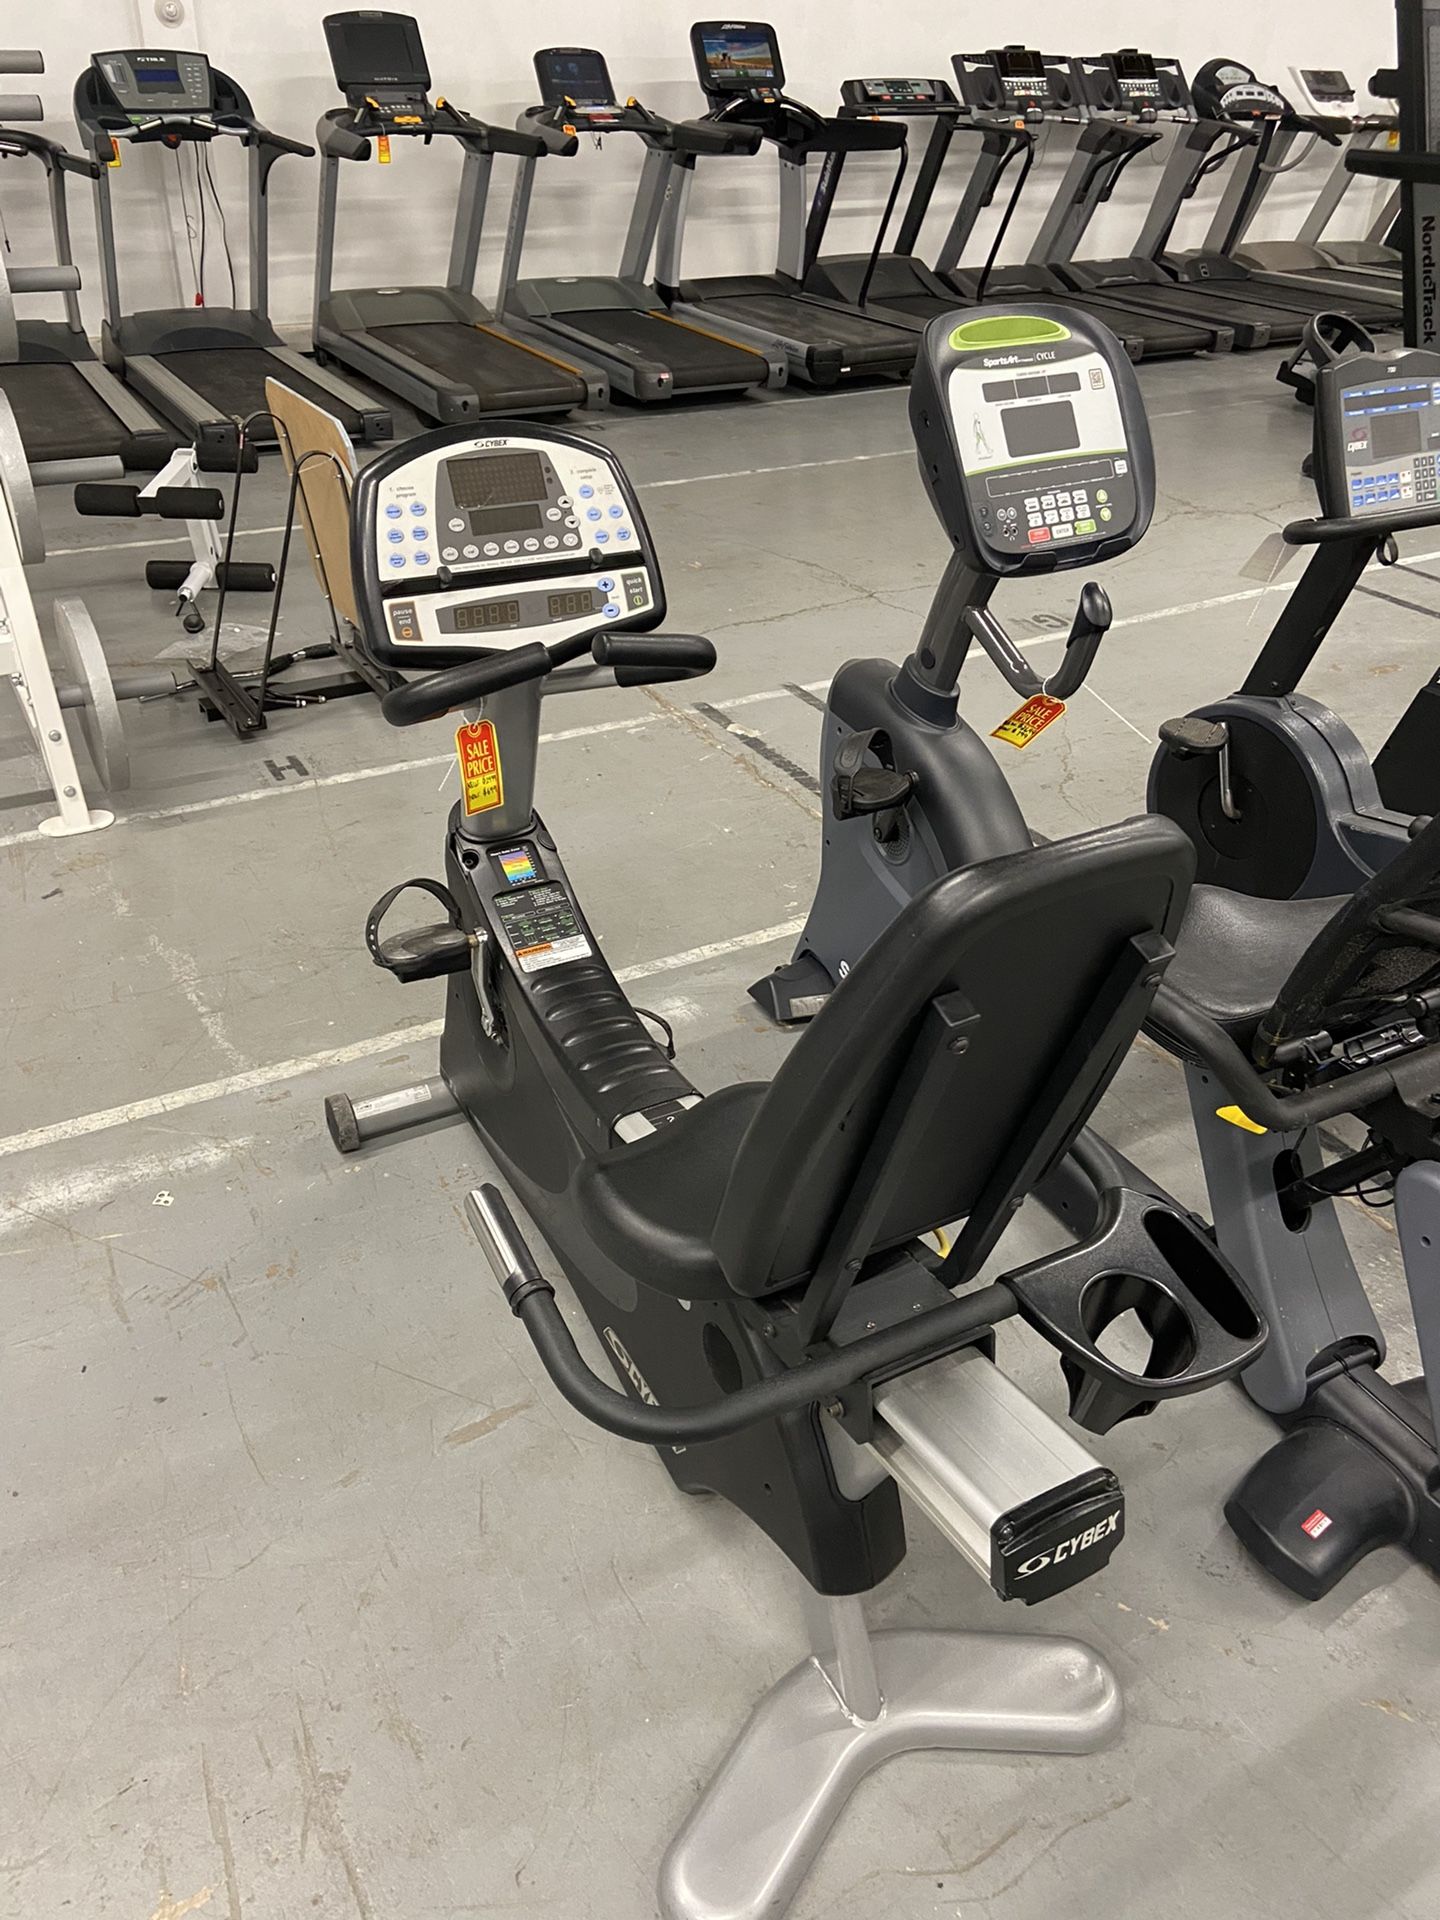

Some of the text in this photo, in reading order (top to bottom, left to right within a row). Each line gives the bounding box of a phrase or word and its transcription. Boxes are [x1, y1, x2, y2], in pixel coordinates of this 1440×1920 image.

[1422, 216, 1437, 344] NordicTrack
[983, 355, 1019, 368] SportsArt
[1036, 351, 1056, 361] CYCLE
[485, 439, 508, 448] CYBEX
[626, 577, 642, 585] quick
[392, 608, 412, 617] pause
[1015, 711, 1045, 729] PRICE
[1026, 704, 1053, 719] SALE
[466, 739, 490, 760] SALE
[263, 754, 310, 781] H
[467, 755, 494, 778] PRICE
[1053, 1510, 1120, 1564] CYBEX
